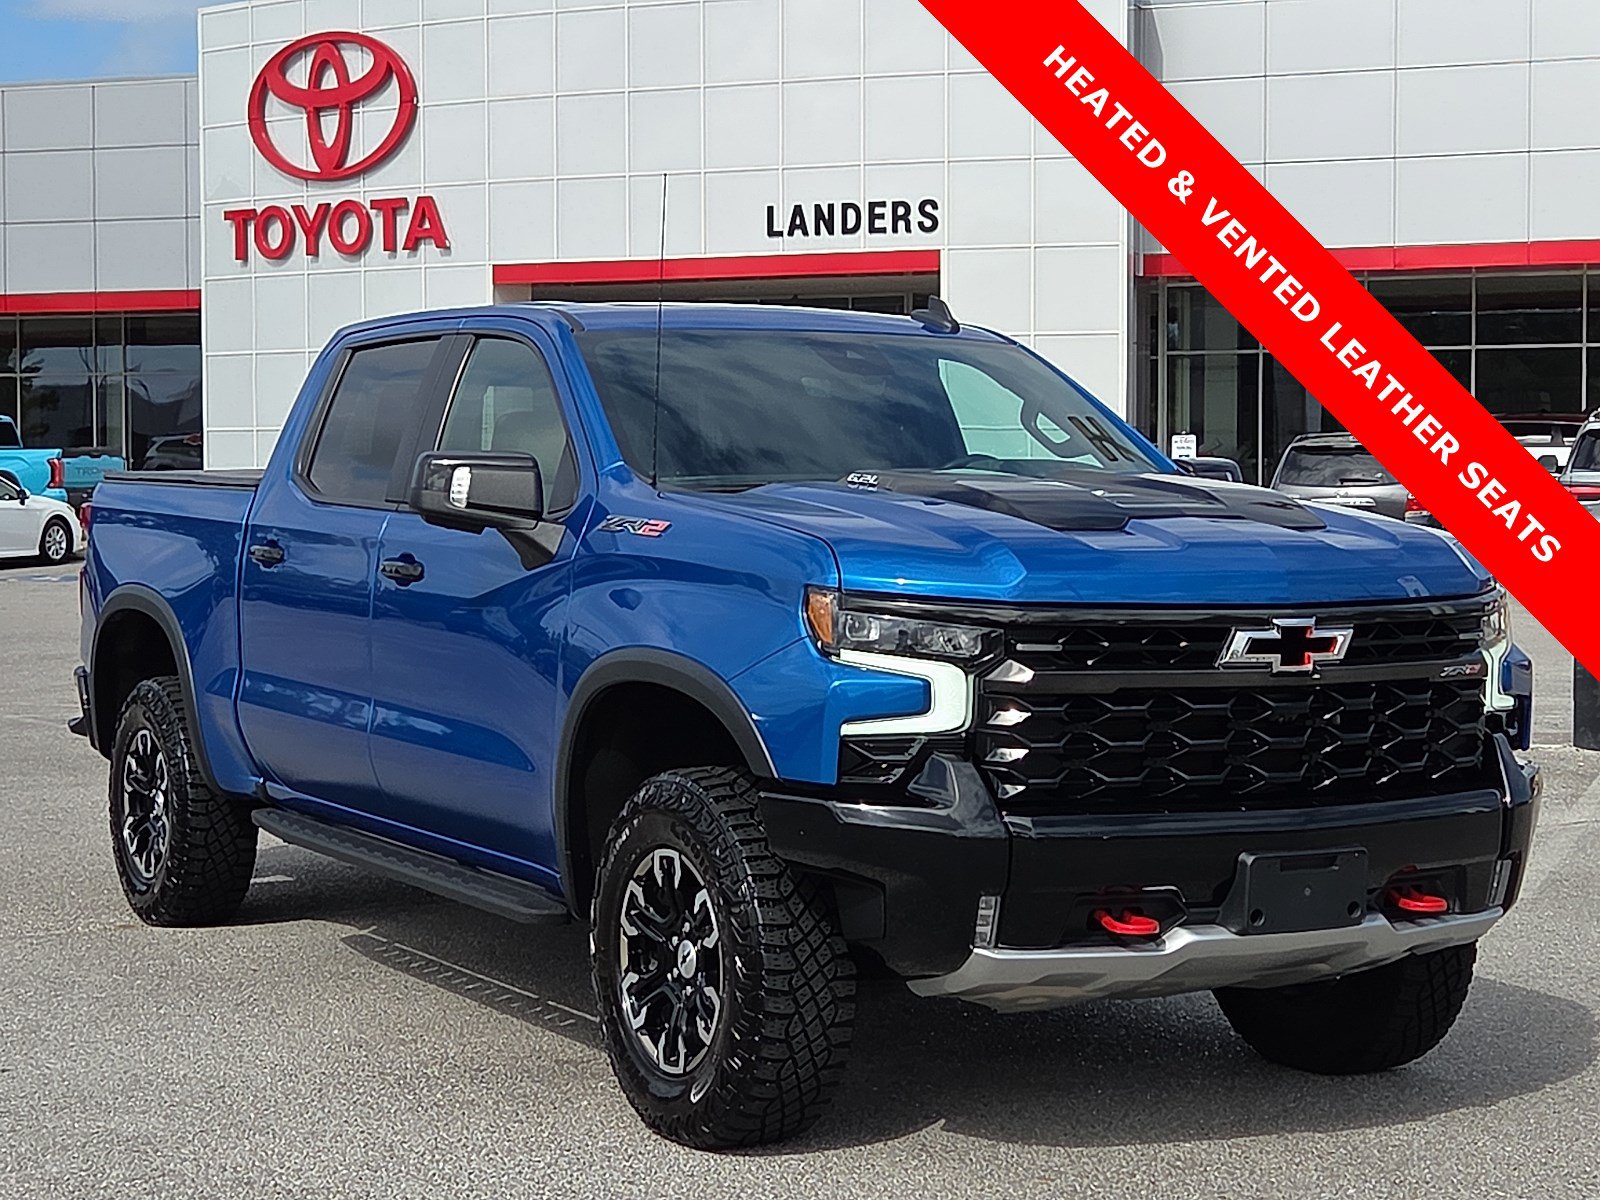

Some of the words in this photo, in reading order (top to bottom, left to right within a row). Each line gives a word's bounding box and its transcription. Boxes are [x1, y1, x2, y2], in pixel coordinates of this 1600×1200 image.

[223, 196, 450, 261] TOYOTA
[766, 199, 939, 238] LANDERS
[600, 515, 672, 537] ZR2
